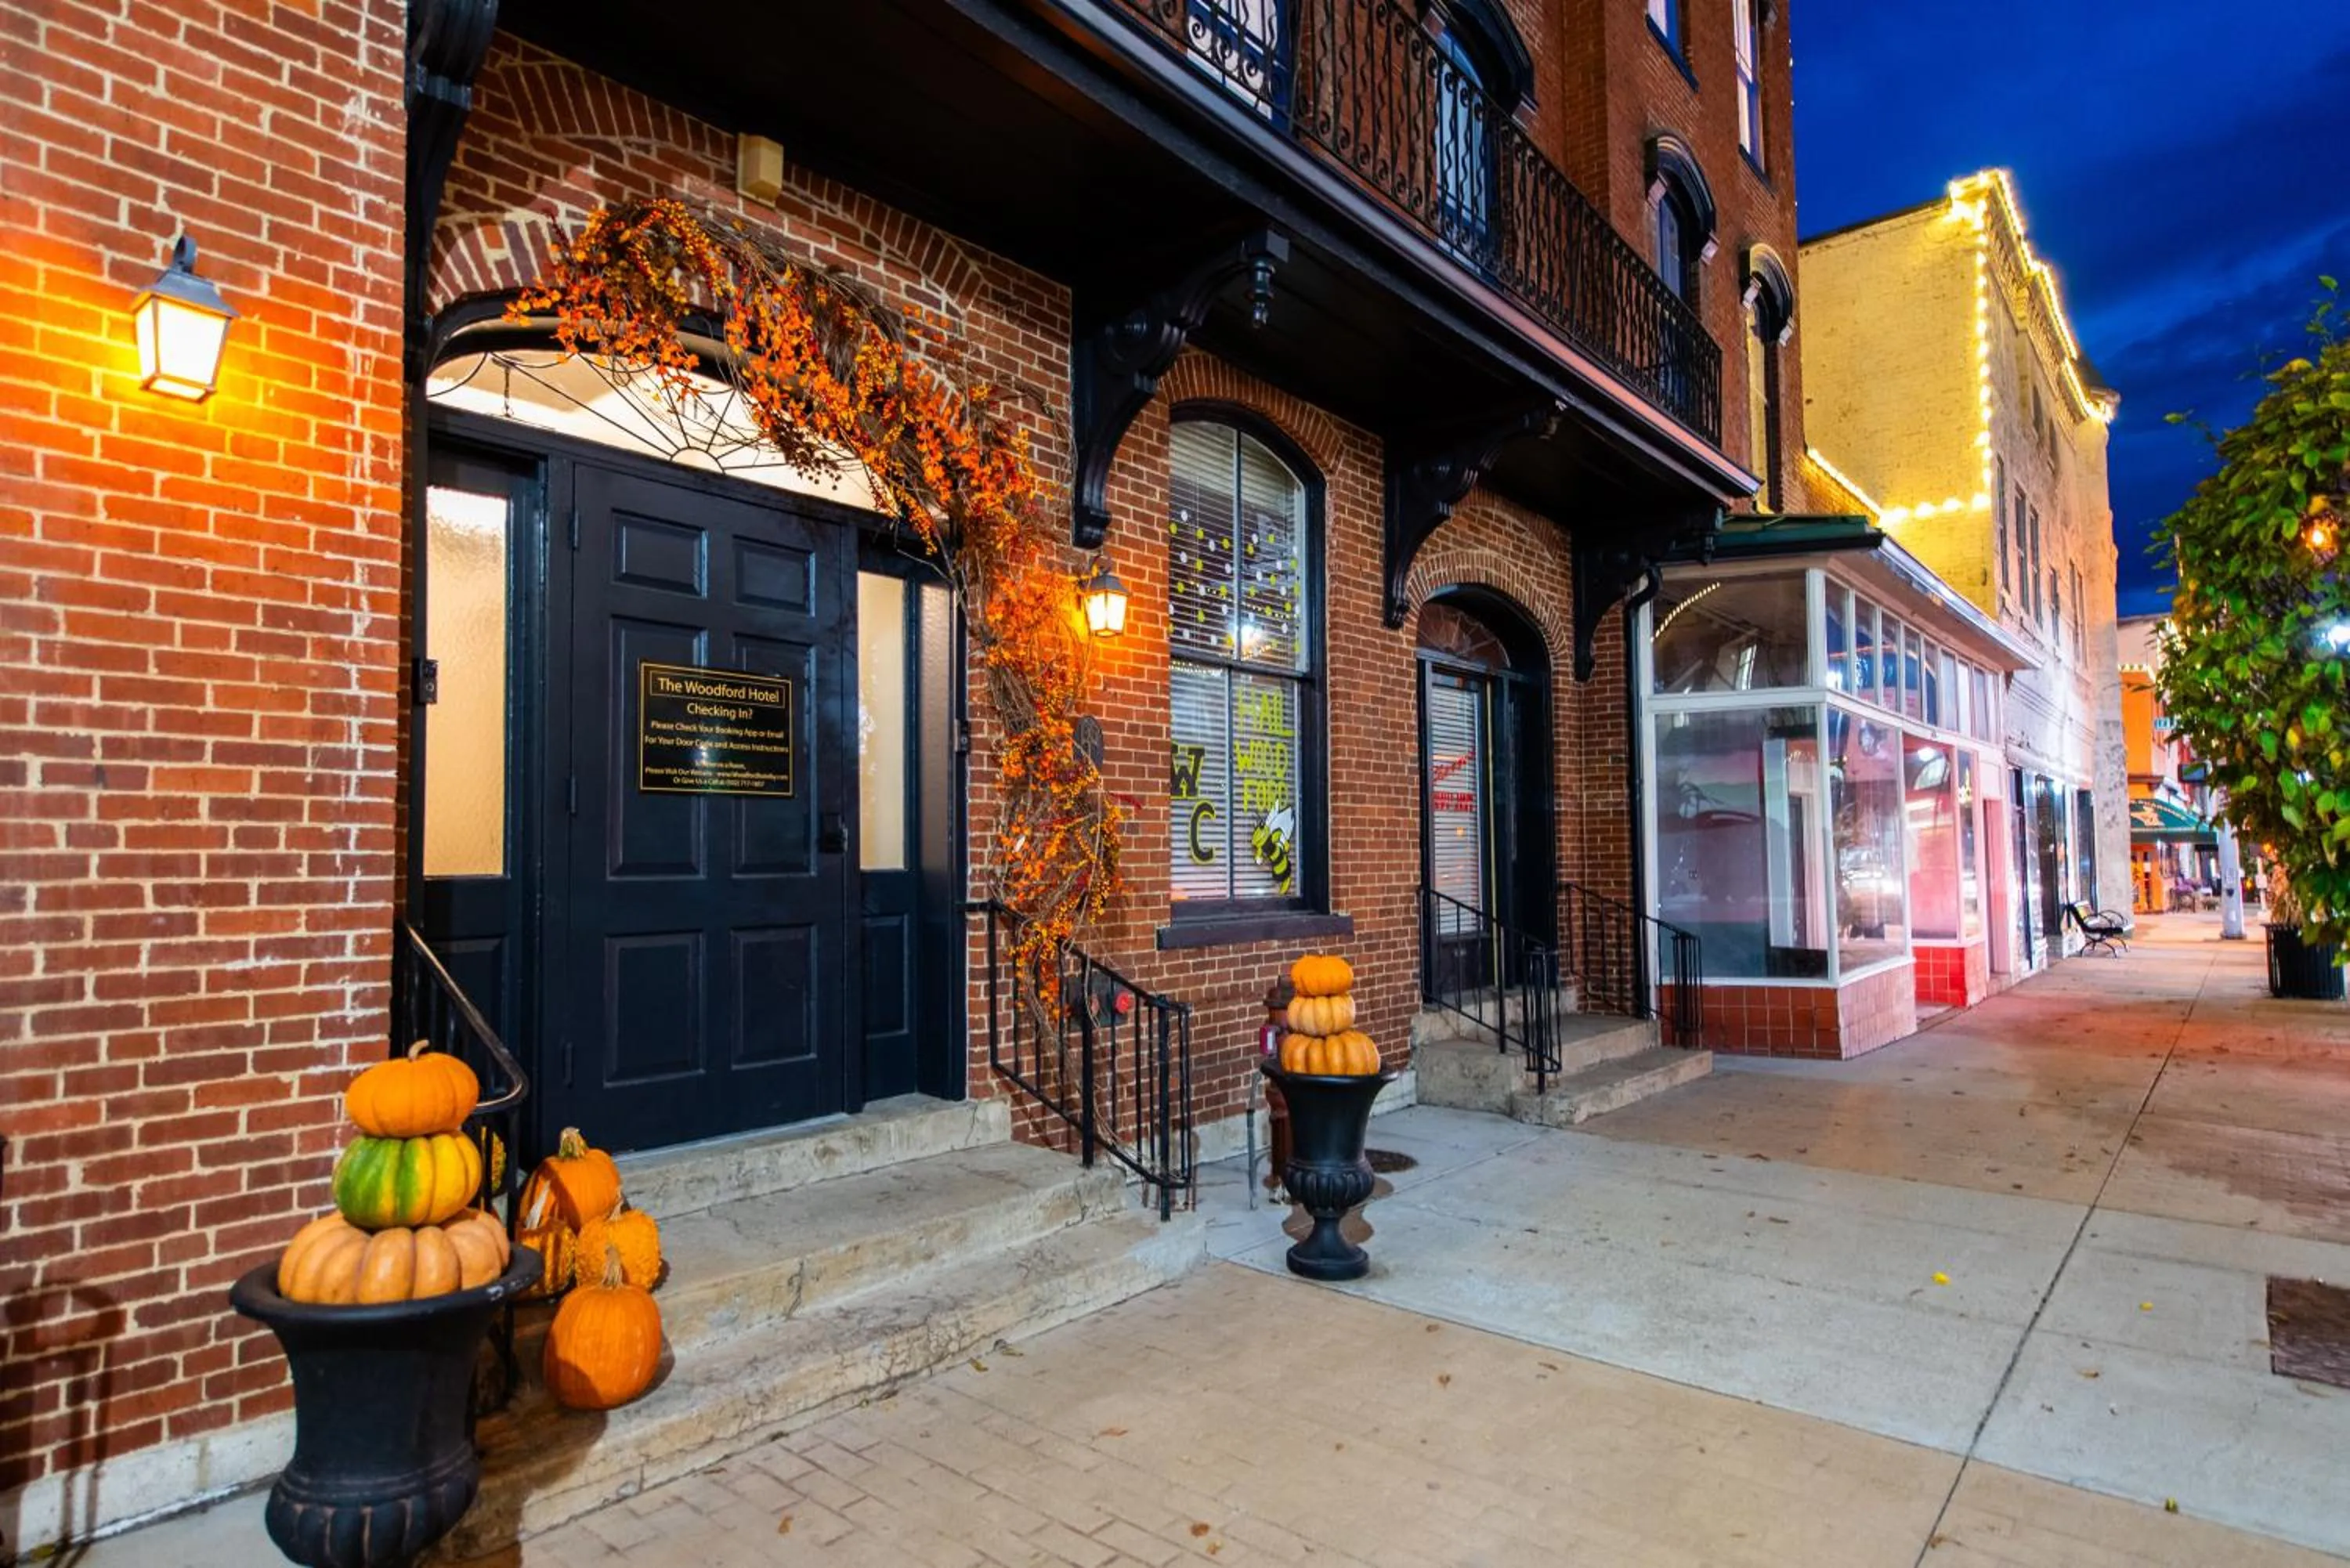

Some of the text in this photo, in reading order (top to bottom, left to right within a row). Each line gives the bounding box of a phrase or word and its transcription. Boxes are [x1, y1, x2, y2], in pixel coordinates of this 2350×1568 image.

[658, 677, 779, 703] The Woodford Hotel
[687, 703, 753, 721] Checking In?
[651, 720, 674, 730] Please
[674, 722, 696, 732] Check
[697, 724, 714, 733] Your
[715, 726, 743, 738] Booking
[645, 735, 656, 744] For
[657, 736, 674, 746] Your
[676, 737, 694, 746] Door
[714, 741, 728, 750] and
[729, 742, 750, 751] Access
[1189, 800, 1216, 865] C
